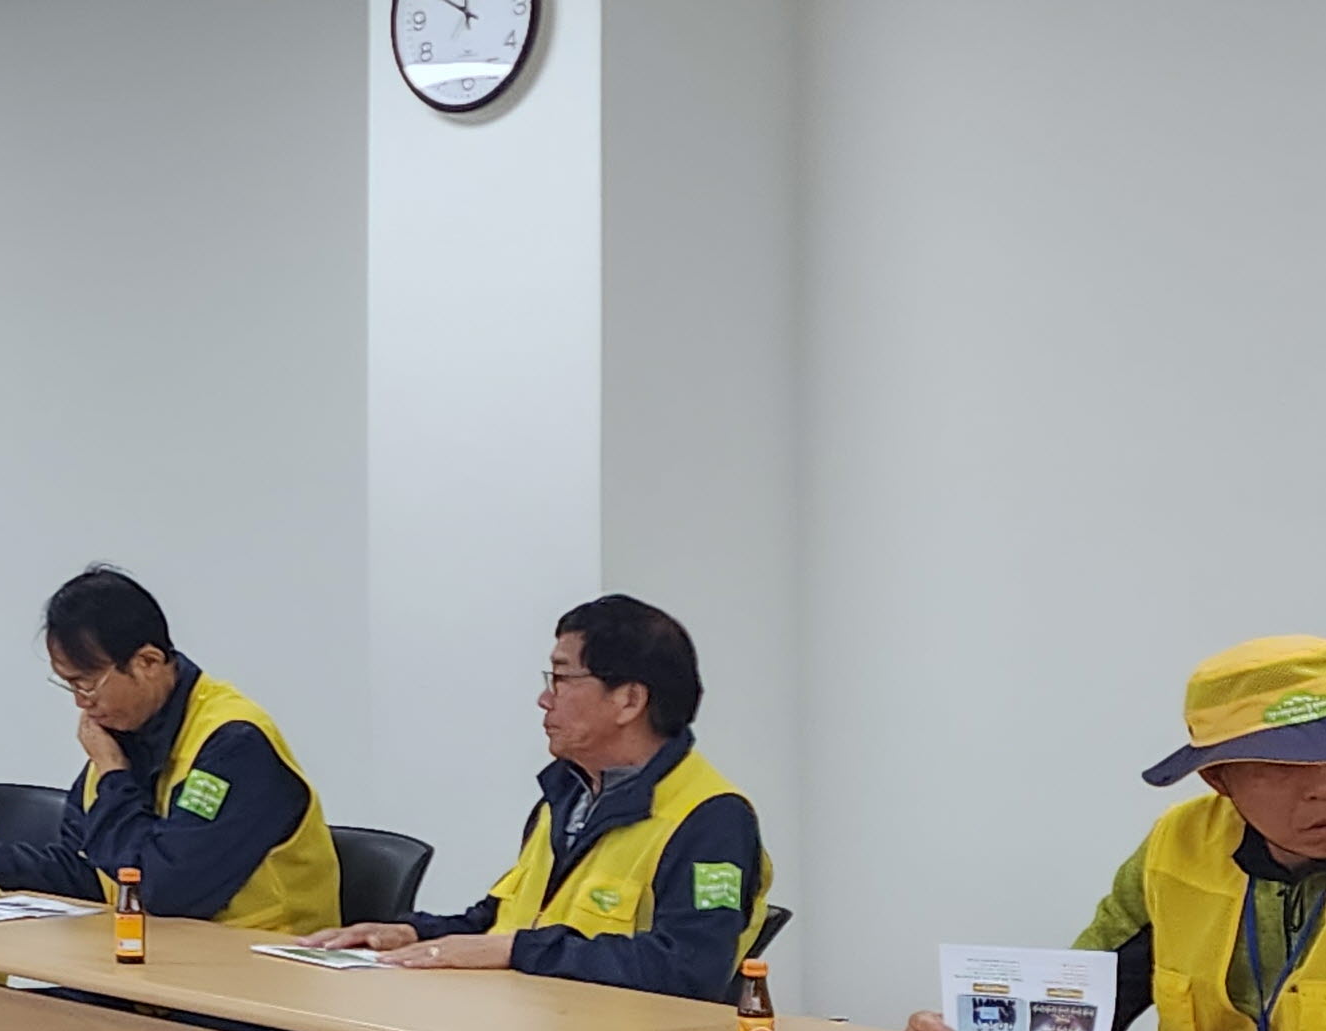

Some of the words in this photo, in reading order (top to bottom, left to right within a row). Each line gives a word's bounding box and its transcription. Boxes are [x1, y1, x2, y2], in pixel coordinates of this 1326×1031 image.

[413, 10, 427, 32] 9
[503, 29, 518, 51] 4
[419, 41, 434, 63] 8
